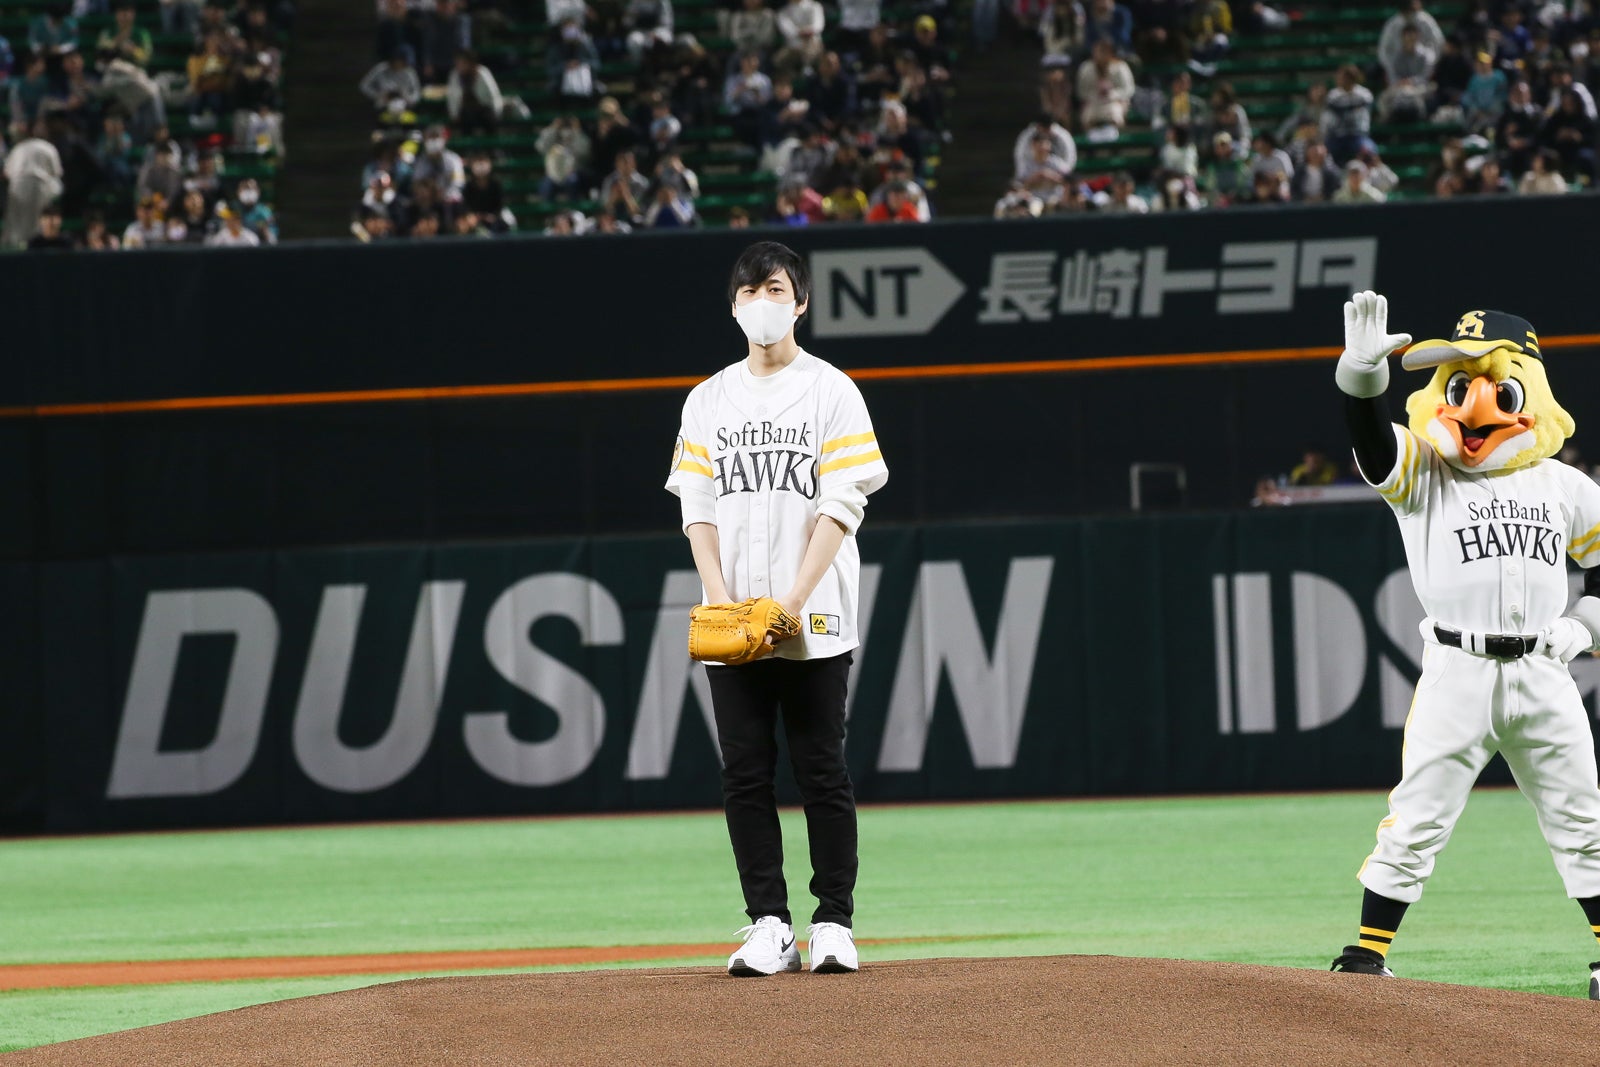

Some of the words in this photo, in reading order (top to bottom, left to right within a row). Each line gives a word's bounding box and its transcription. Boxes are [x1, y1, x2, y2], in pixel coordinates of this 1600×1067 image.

[829, 264, 921, 320] NT
[977, 237, 1378, 323] 長崎トヨタ
[717, 421, 812, 451] SoftBank
[1468, 498, 1551, 524] SoftBank
[1453, 522, 1562, 567] HAWKS
